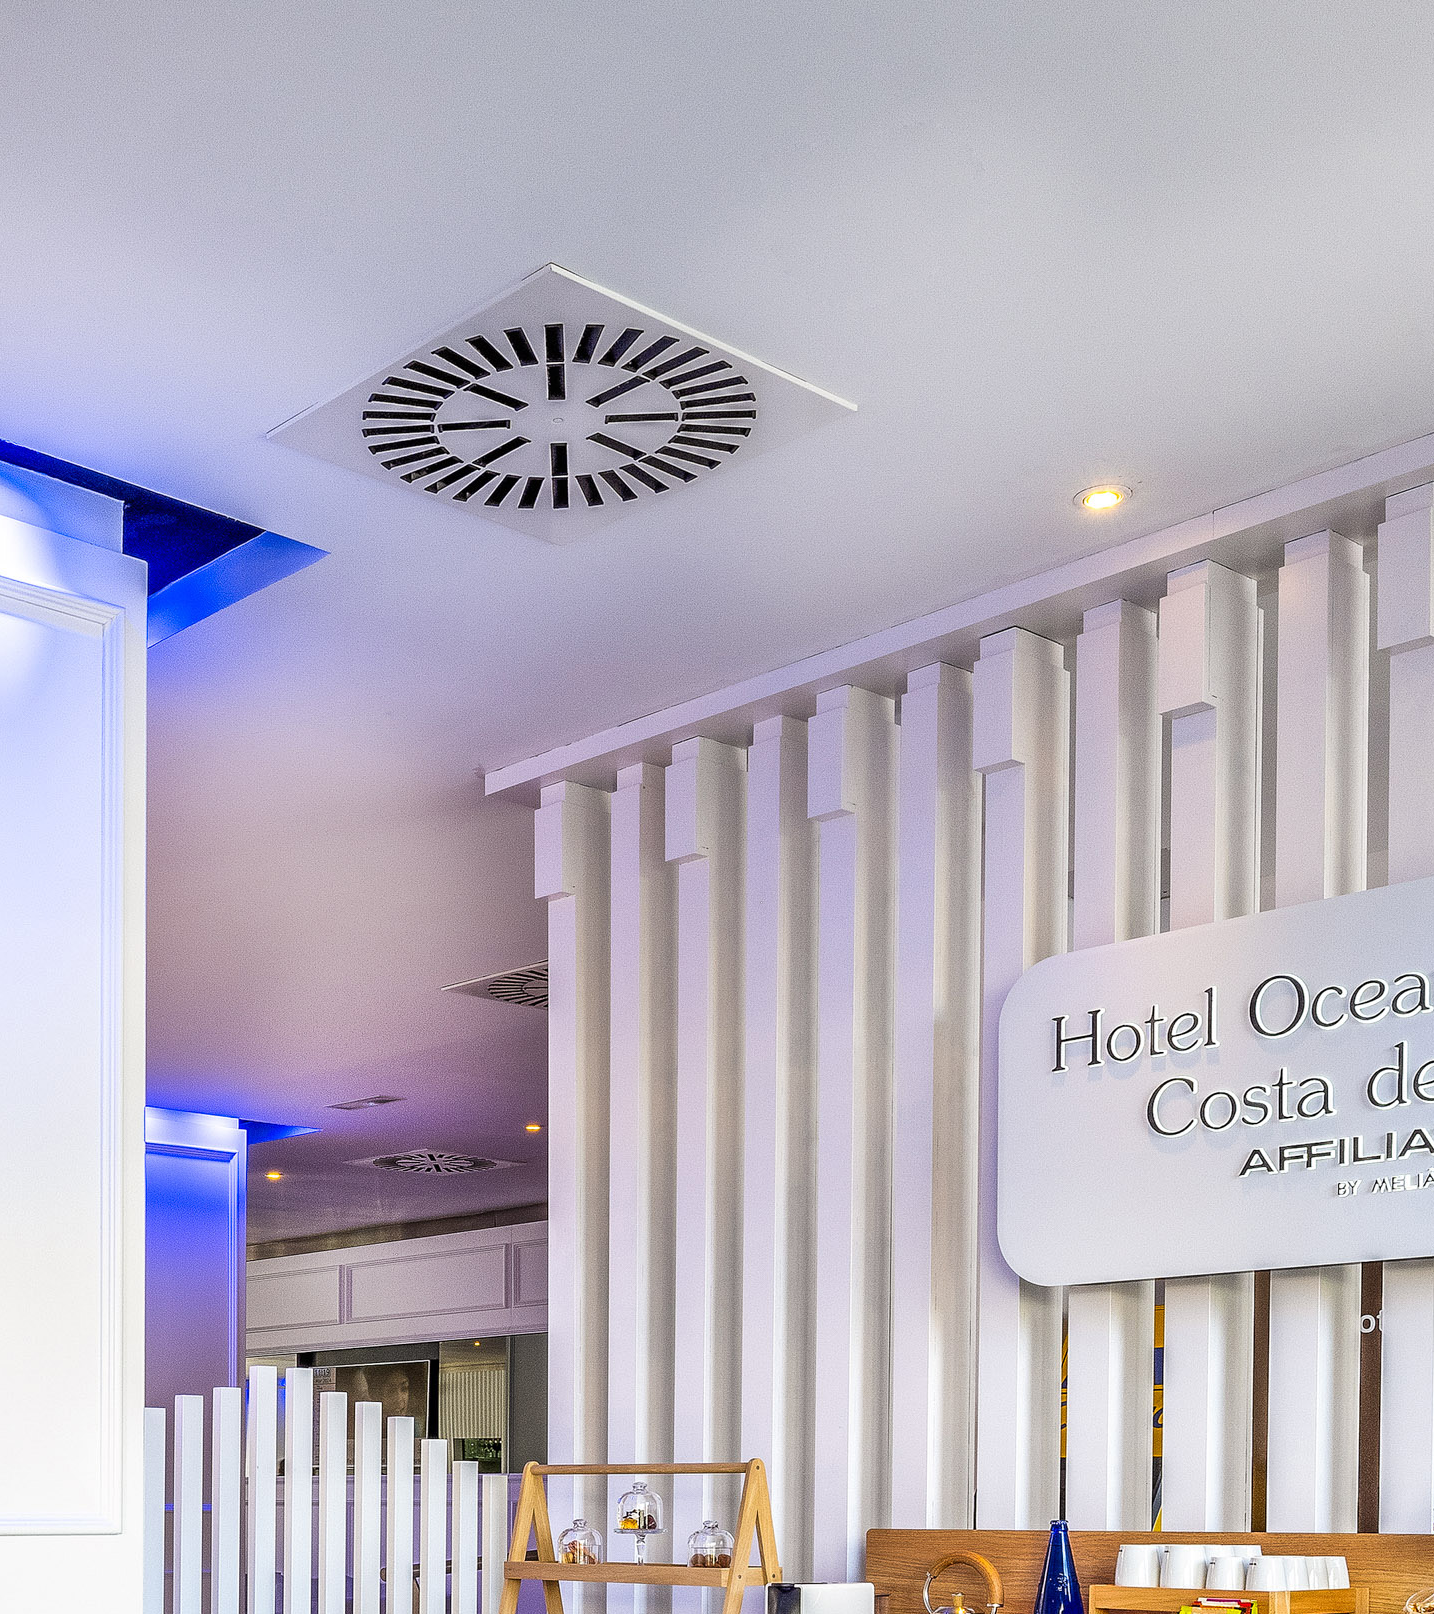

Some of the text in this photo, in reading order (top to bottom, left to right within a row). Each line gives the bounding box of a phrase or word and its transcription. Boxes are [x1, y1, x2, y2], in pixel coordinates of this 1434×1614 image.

[1051, 986, 1219, 1072] Hotel
[1146, 1067, 1336, 1138] Costa
[1337, 1179, 1361, 1197] BY
